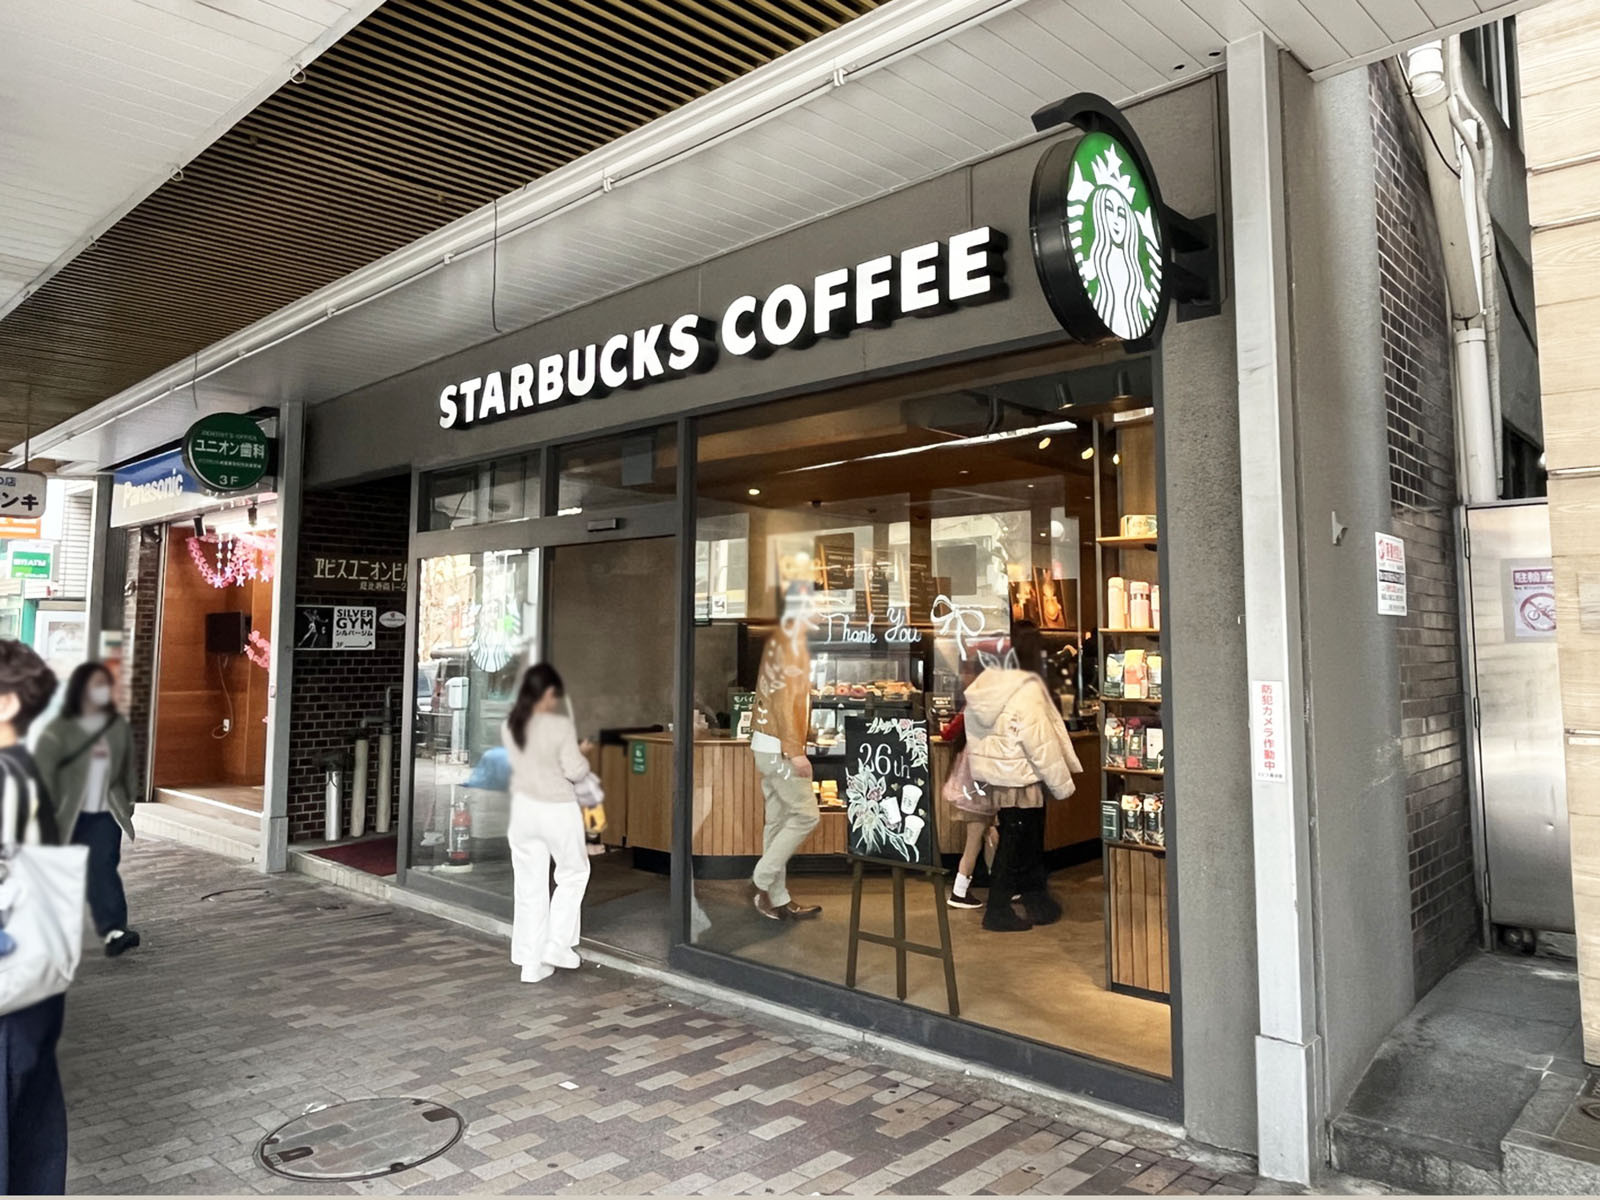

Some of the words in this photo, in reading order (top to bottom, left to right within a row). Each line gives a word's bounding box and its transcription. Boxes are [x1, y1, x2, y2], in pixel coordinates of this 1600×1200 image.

[438, 313, 701, 430] STARBUCKS
[720, 226, 992, 356] COFFEE
[194, 440, 265, 459] ユニオン歯科
[123, 468, 184, 509] Panasonic
[219, 474, 239, 486] 3F
[1, 494, 39, 511] ンキ
[336, 608, 374, 618] SILVER
[336, 617, 373, 630] GYM
[818, 612, 878, 645] Thank
[884, 607, 922, 643] You
[1261, 684, 1275, 771] 防犯カメラ作動中
[859, 742, 910, 780] 26th
